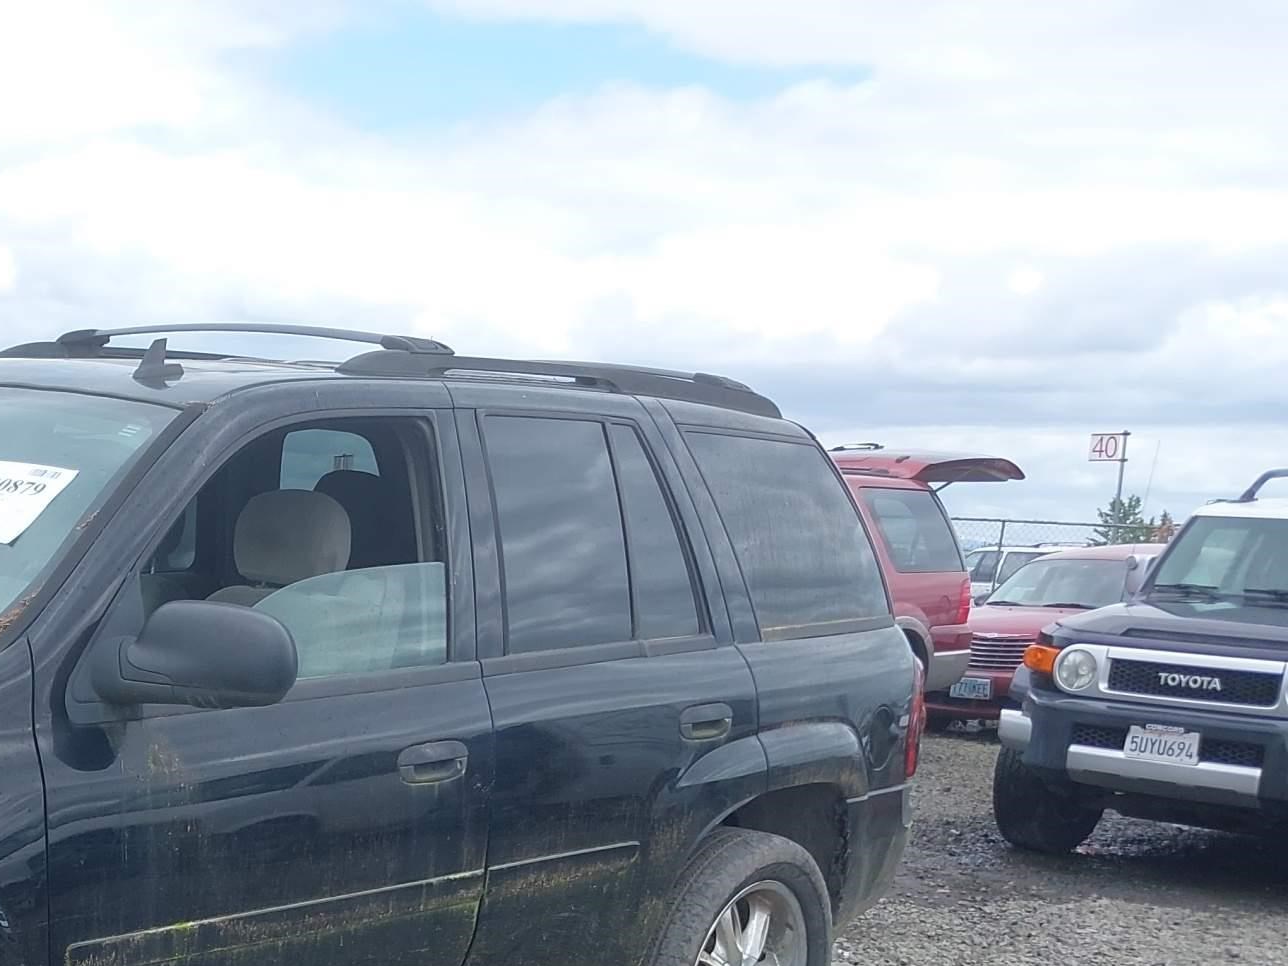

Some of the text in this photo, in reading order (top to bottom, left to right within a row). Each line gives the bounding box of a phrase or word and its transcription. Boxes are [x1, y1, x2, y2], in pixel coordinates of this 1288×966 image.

[1092, 436, 1117, 458] 40
[1158, 672, 1222, 691] TOYOTA
[1128, 735, 1194, 760] 5UYU694
